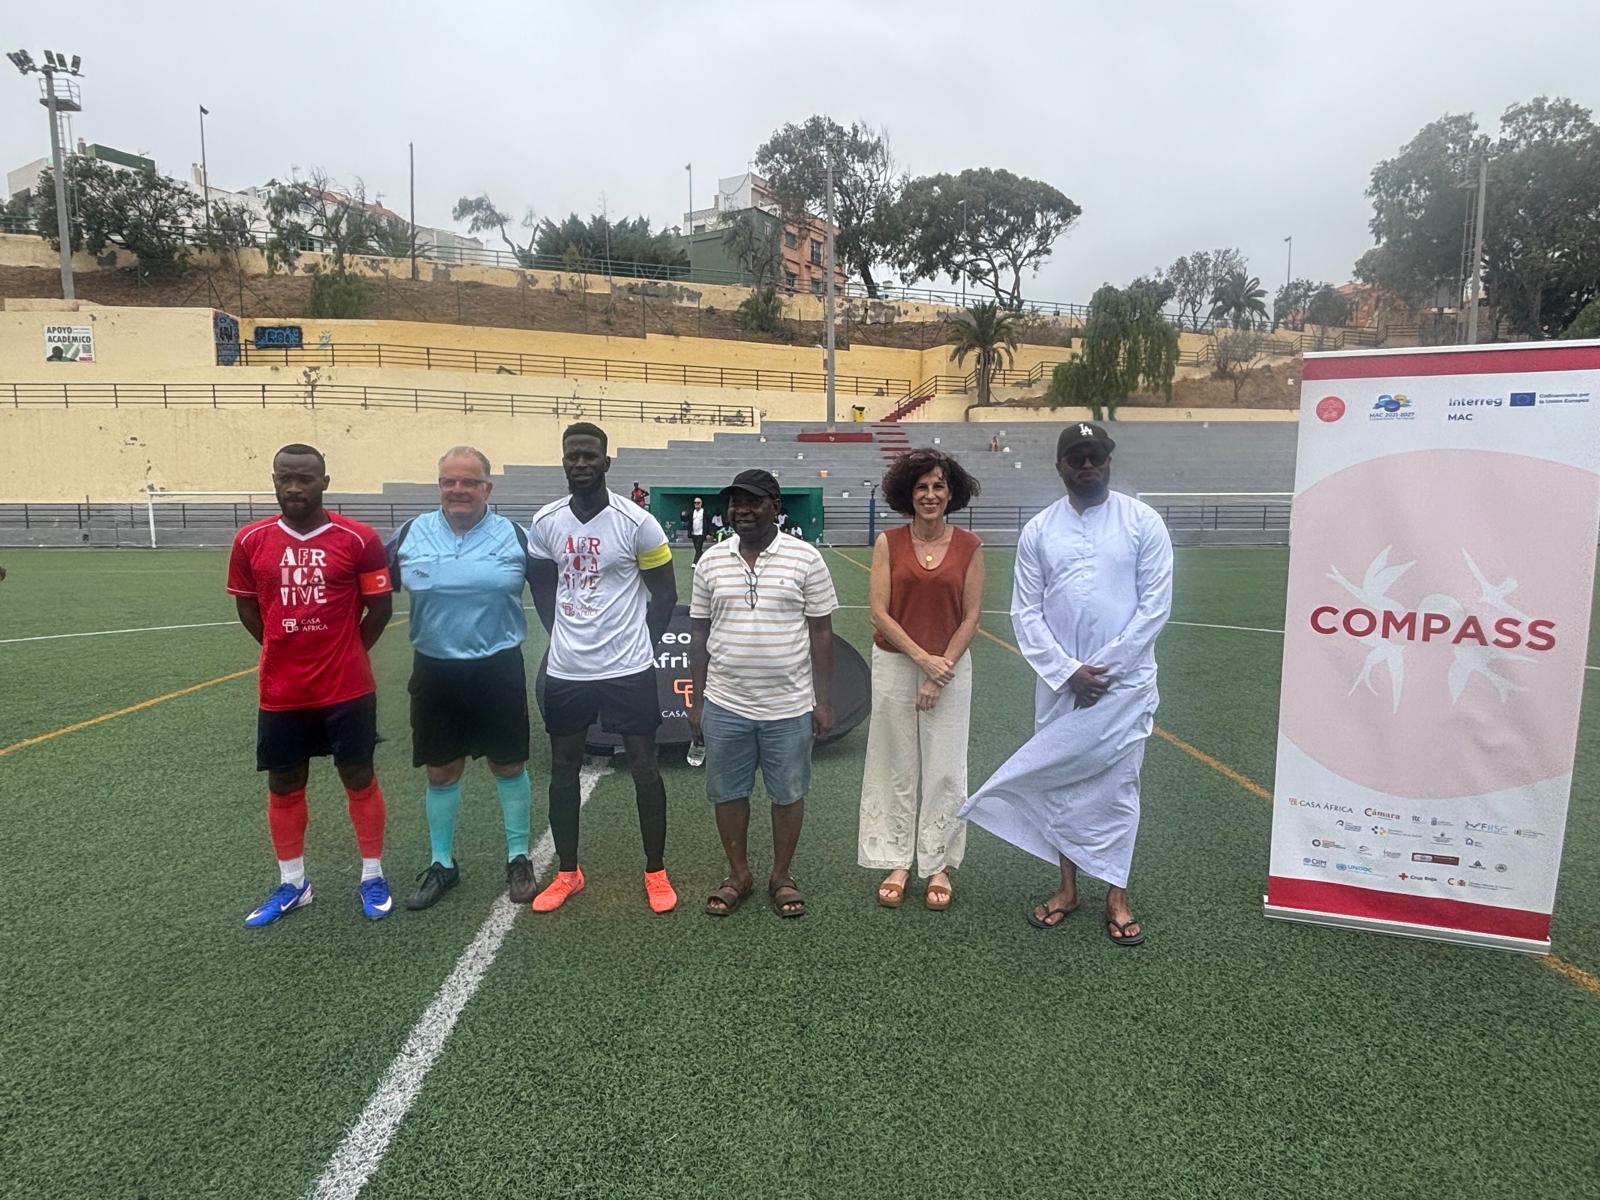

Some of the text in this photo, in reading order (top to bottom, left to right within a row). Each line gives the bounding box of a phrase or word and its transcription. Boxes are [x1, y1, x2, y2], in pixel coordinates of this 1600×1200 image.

[47, 326, 73, 334] APOYO
[1447, 413, 1474, 421] MAC
[1078, 423, 1094, 436] LA
[280, 567, 326, 586] ICA
[300, 617, 321, 625] CASA
[1310, 605, 1557, 651] COMPASS
[658, 632, 692, 644] eo
[661, 710, 688, 718] CASA
[1299, 799, 1321, 809] CASA
